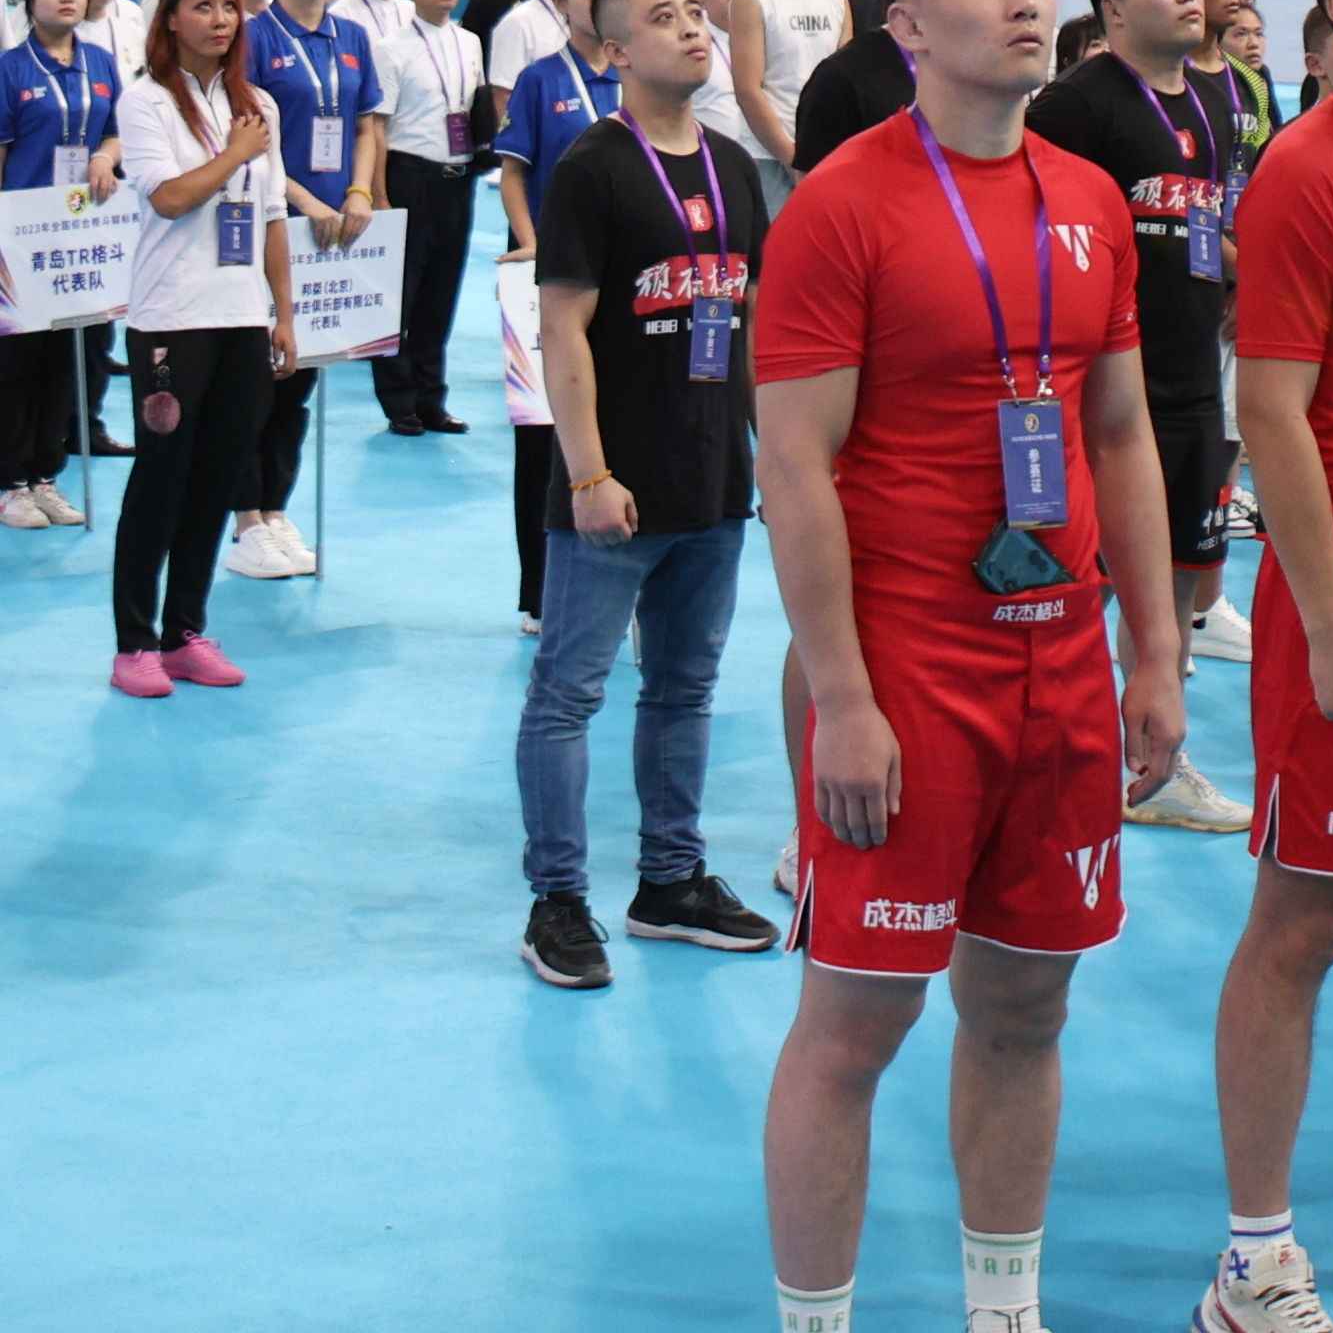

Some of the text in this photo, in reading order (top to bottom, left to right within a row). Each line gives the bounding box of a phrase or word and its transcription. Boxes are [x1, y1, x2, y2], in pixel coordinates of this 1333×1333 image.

[789, 15, 832, 31] CHINA
[31, 242, 125, 272] 青岛TR格斗
[52, 270, 105, 295] 代表队
[311, 315, 342, 332] 代表队
[992, 598, 1066, 622] 成杰格斗
[863, 898, 958, 931] 成杰格斗
